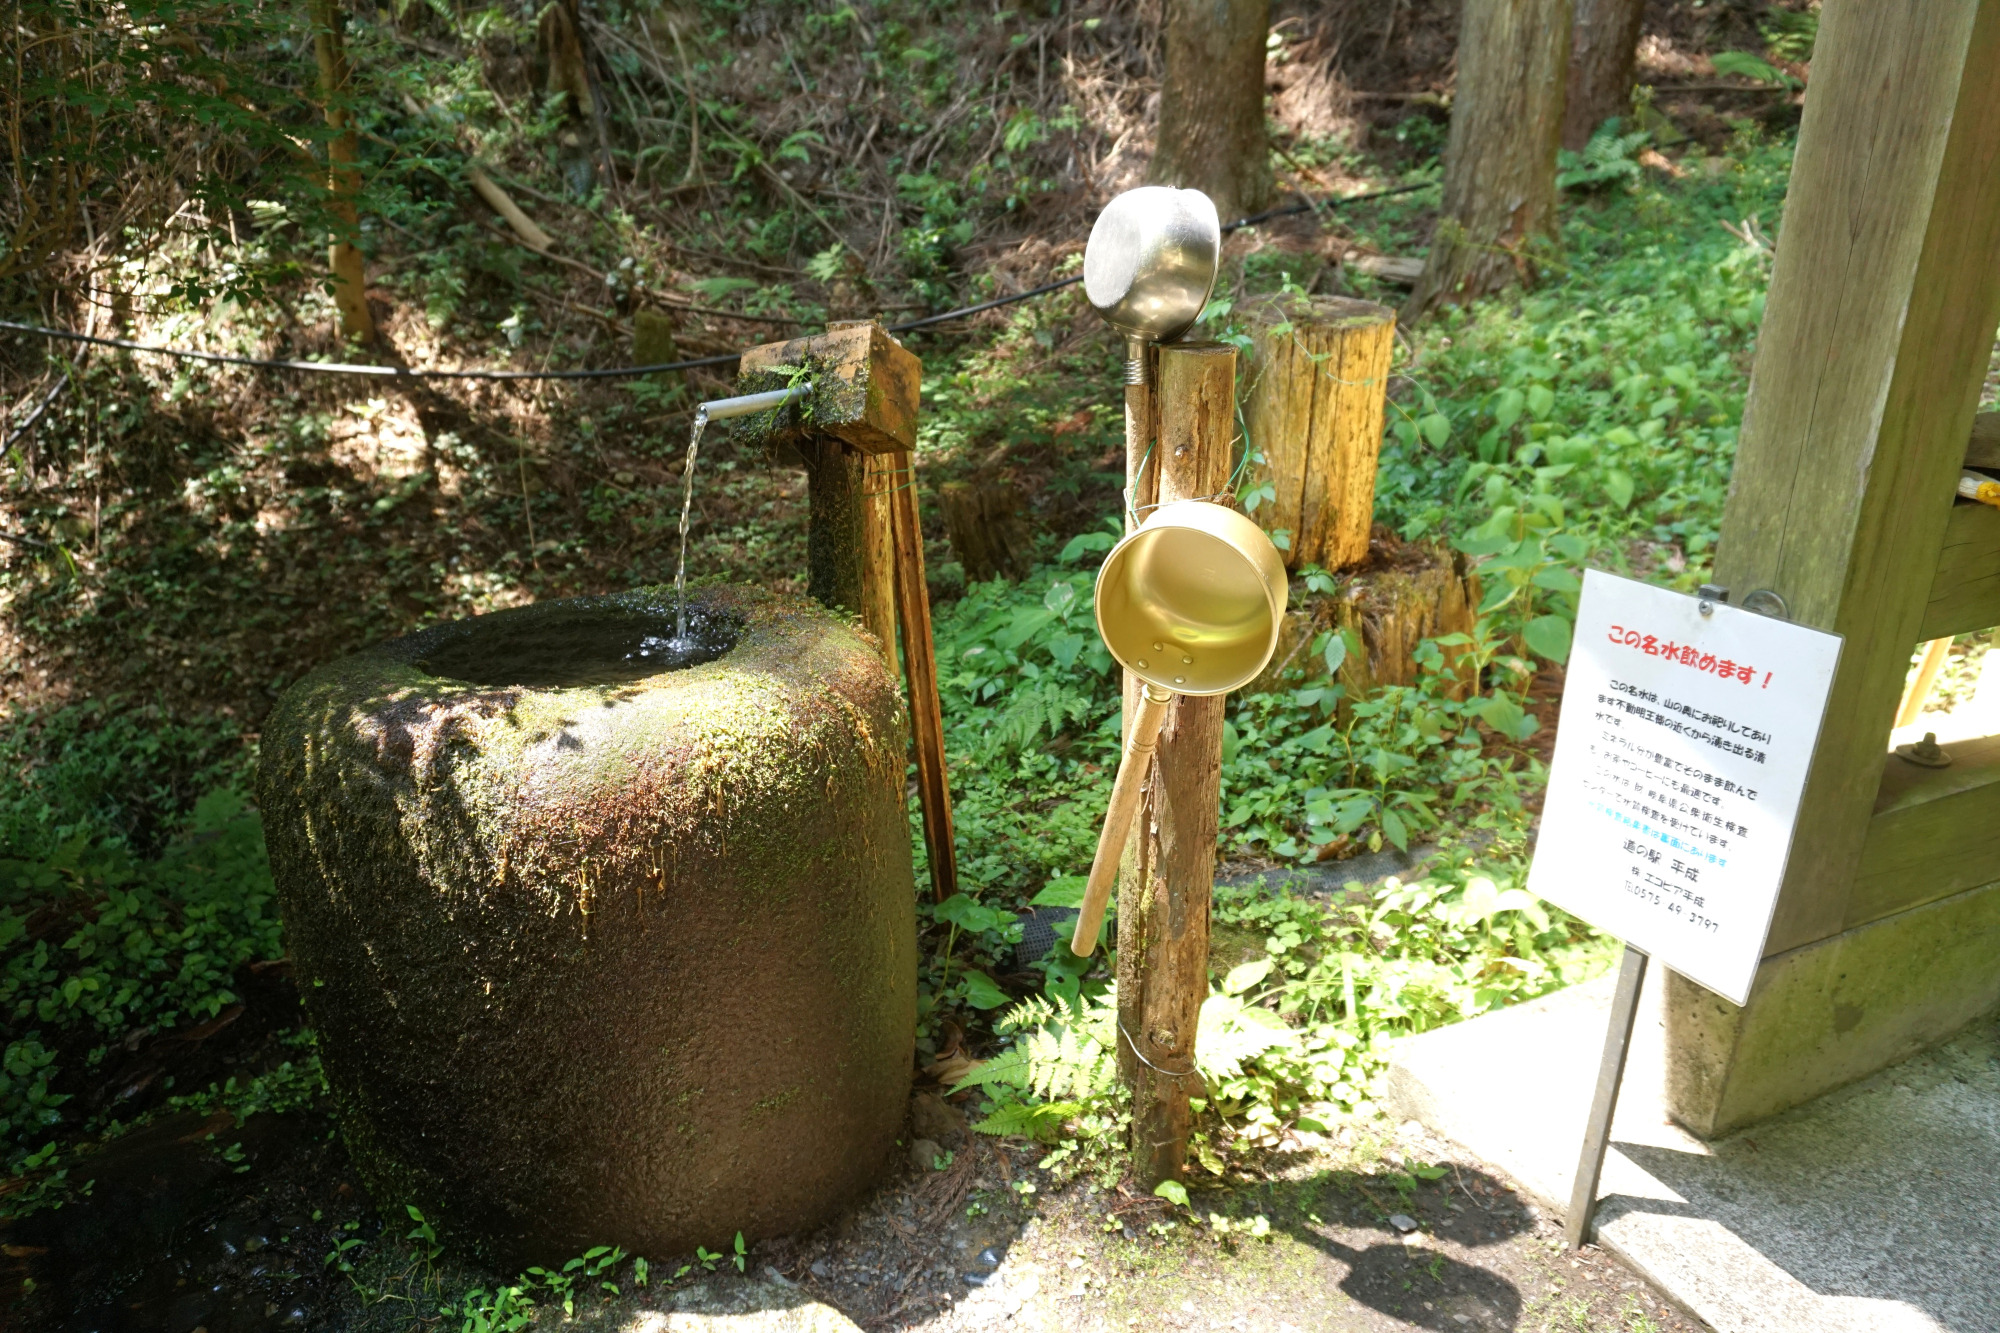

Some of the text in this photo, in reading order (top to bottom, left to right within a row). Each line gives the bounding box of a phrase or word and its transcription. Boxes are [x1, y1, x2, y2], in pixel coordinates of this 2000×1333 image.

[1607, 624, 1773, 690] この名水飲めます！
[1621, 839, 1700, 883] 道の駅 平成
